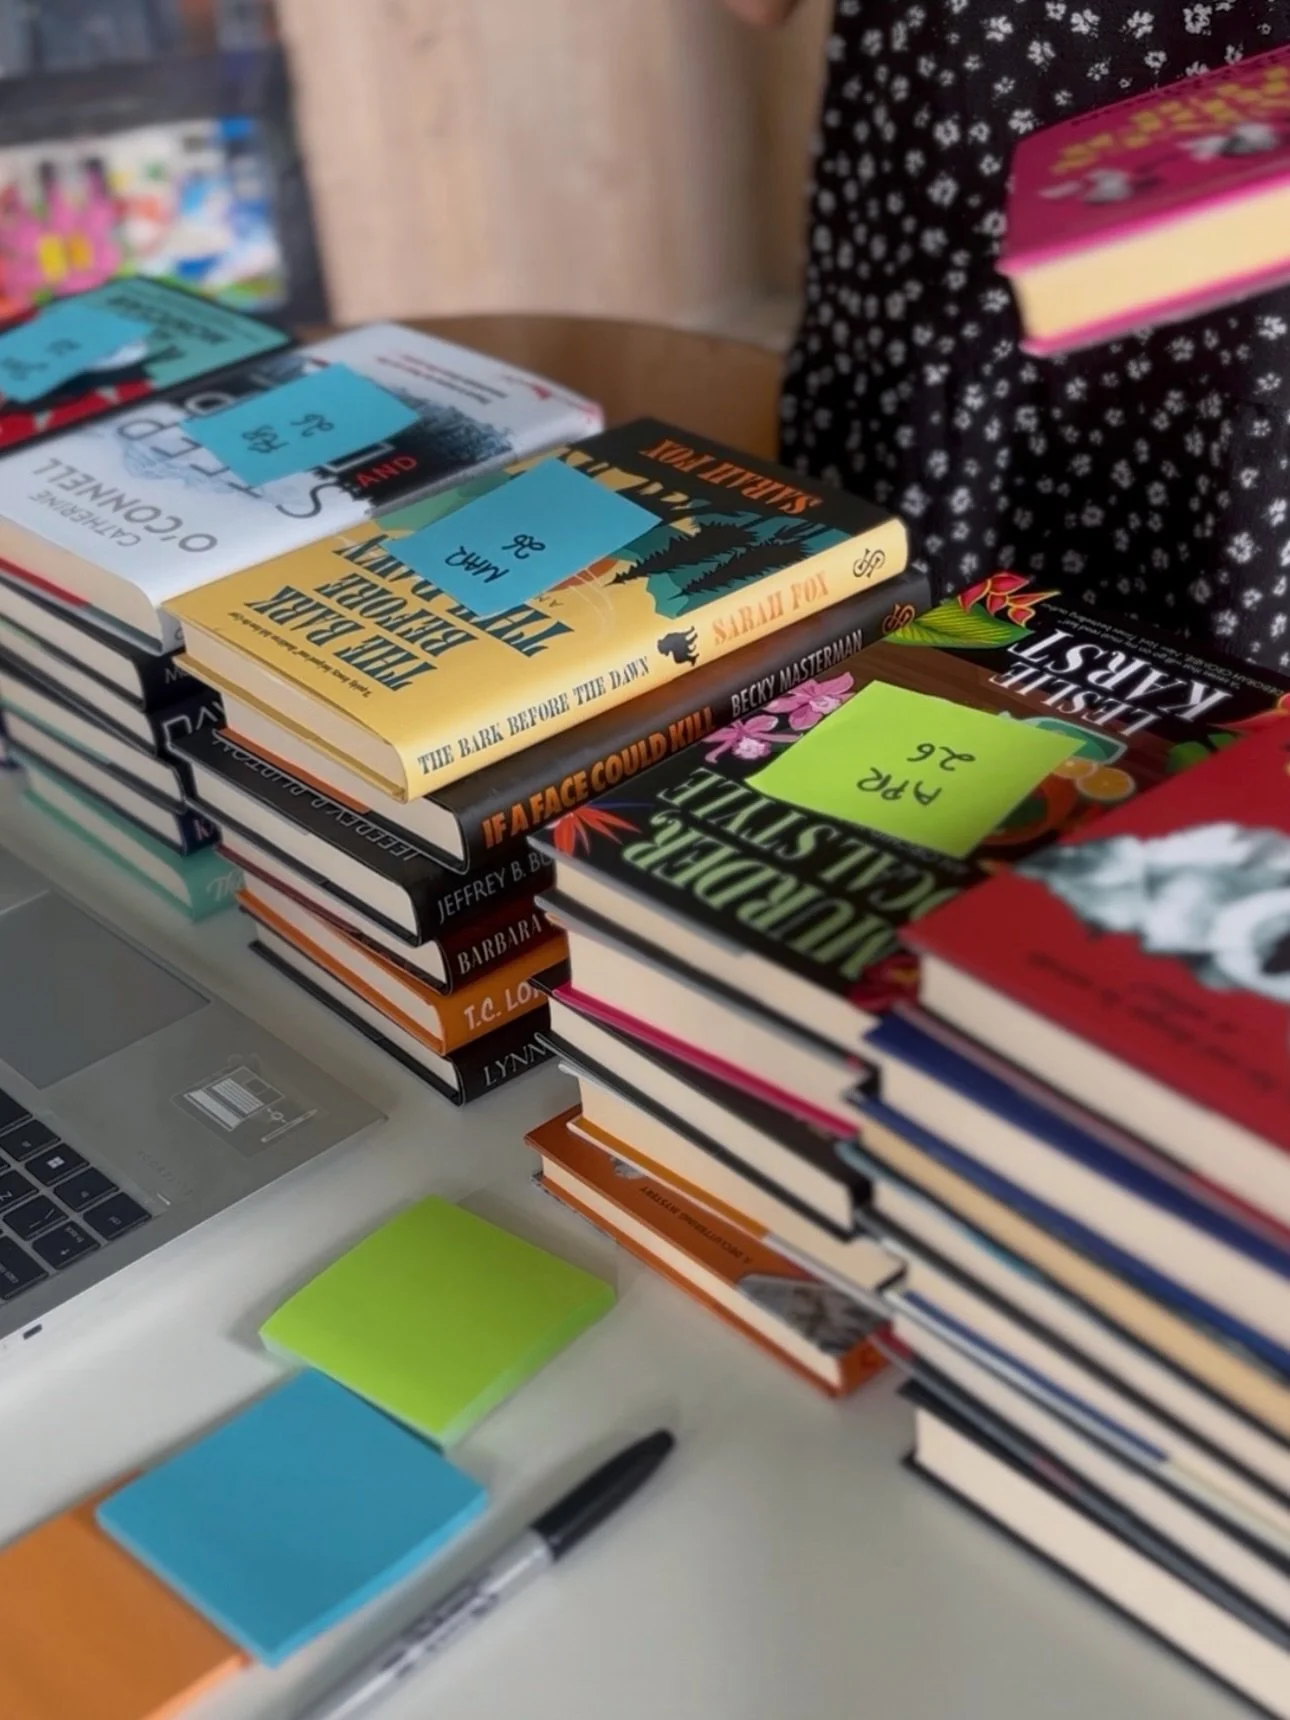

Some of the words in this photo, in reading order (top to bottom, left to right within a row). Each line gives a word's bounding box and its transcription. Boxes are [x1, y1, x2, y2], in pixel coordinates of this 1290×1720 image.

[290, 413, 335, 437] 26
[356, 455, 418, 488] AND
[648, 439, 716, 472] FOX
[27, 488, 142, 548] CATHERINE
[32, 457, 218, 552] O'CONNELL
[697, 462, 824, 515] SARAH
[445, 545, 510, 583] MAR
[501, 534, 546, 560] 26
[243, 585, 367, 647] BARK
[312, 572, 478, 657] BEFORE
[711, 589, 786, 646] SARAH
[790, 570, 831, 619] FOX
[332, 635, 438, 691] THE
[731, 673, 776, 718] BECKY
[779, 629, 864, 697] MASTERMAN
[1008, 628, 1232, 722] KARST
[417, 744, 453, 775] THE
[458, 722, 505, 758] BARK
[506, 692, 570, 737] BEFORE
[572, 675, 606, 707] THE
[609, 656, 651, 691] DAWN
[989, 662, 1161, 737] LESLIE
[480, 813, 506, 849] IF
[511, 803, 528, 836] A
[529, 772, 589, 820] FACE
[590, 731, 668, 790] COULD
[668, 706, 715, 751] KILL
[857, 767, 943, 807] APR
[907, 743, 976, 772] 26
[656, 767, 841, 861] STYLE
[437, 869, 506, 925] JEFFREY
[511, 860, 526, 883] B.
[457, 914, 543, 975] BARBARA
[464, 998, 501, 1031] T.C.
[640, 1187, 679, 1214] MYSTERY
